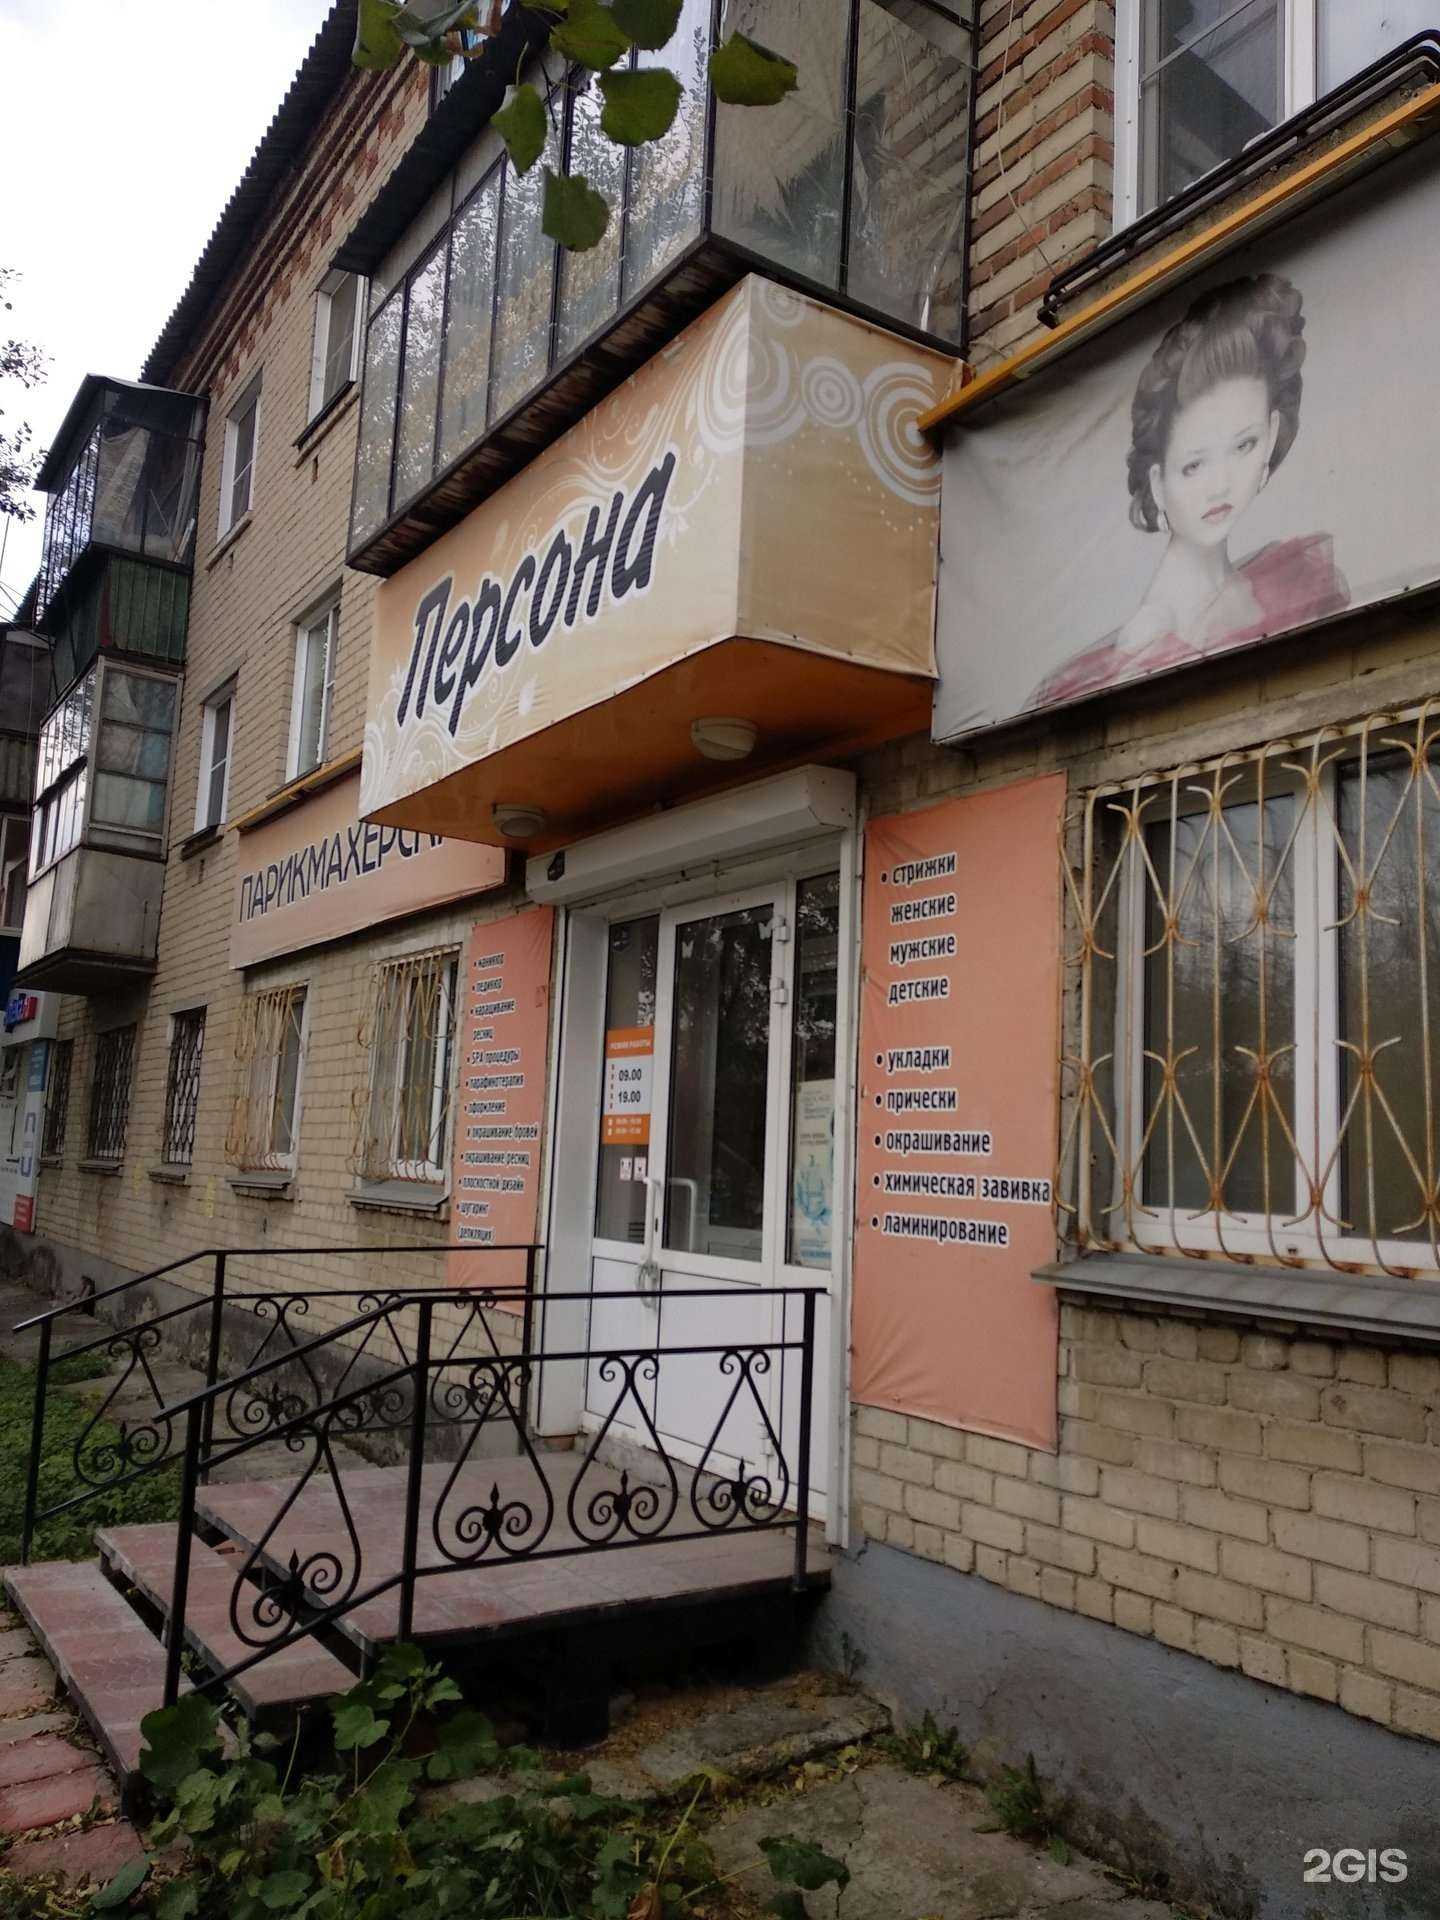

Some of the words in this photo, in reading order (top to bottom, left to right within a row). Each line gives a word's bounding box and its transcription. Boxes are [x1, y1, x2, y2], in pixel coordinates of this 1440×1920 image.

[396, 450, 677, 738] Персона
[239, 821, 443, 923] ПАРИКМАХЕРС
[892, 854, 956, 885] стрижки
[891, 895, 955, 923] женские
[890, 935, 955, 964] мужские
[888, 977, 948, 1004] детские
[888, 1048, 950, 1072] укладки
[618, 1068, 642, 1082] 09.00
[618, 1090, 641, 1104] 19.00
[887, 1090, 956, 1113] прически
[886, 1131, 990, 1154] окрашивание
[885, 1173, 975, 1197] химическая
[982, 1179, 1050, 1202] завивка
[883, 1214, 1008, 1244] ламинирование
